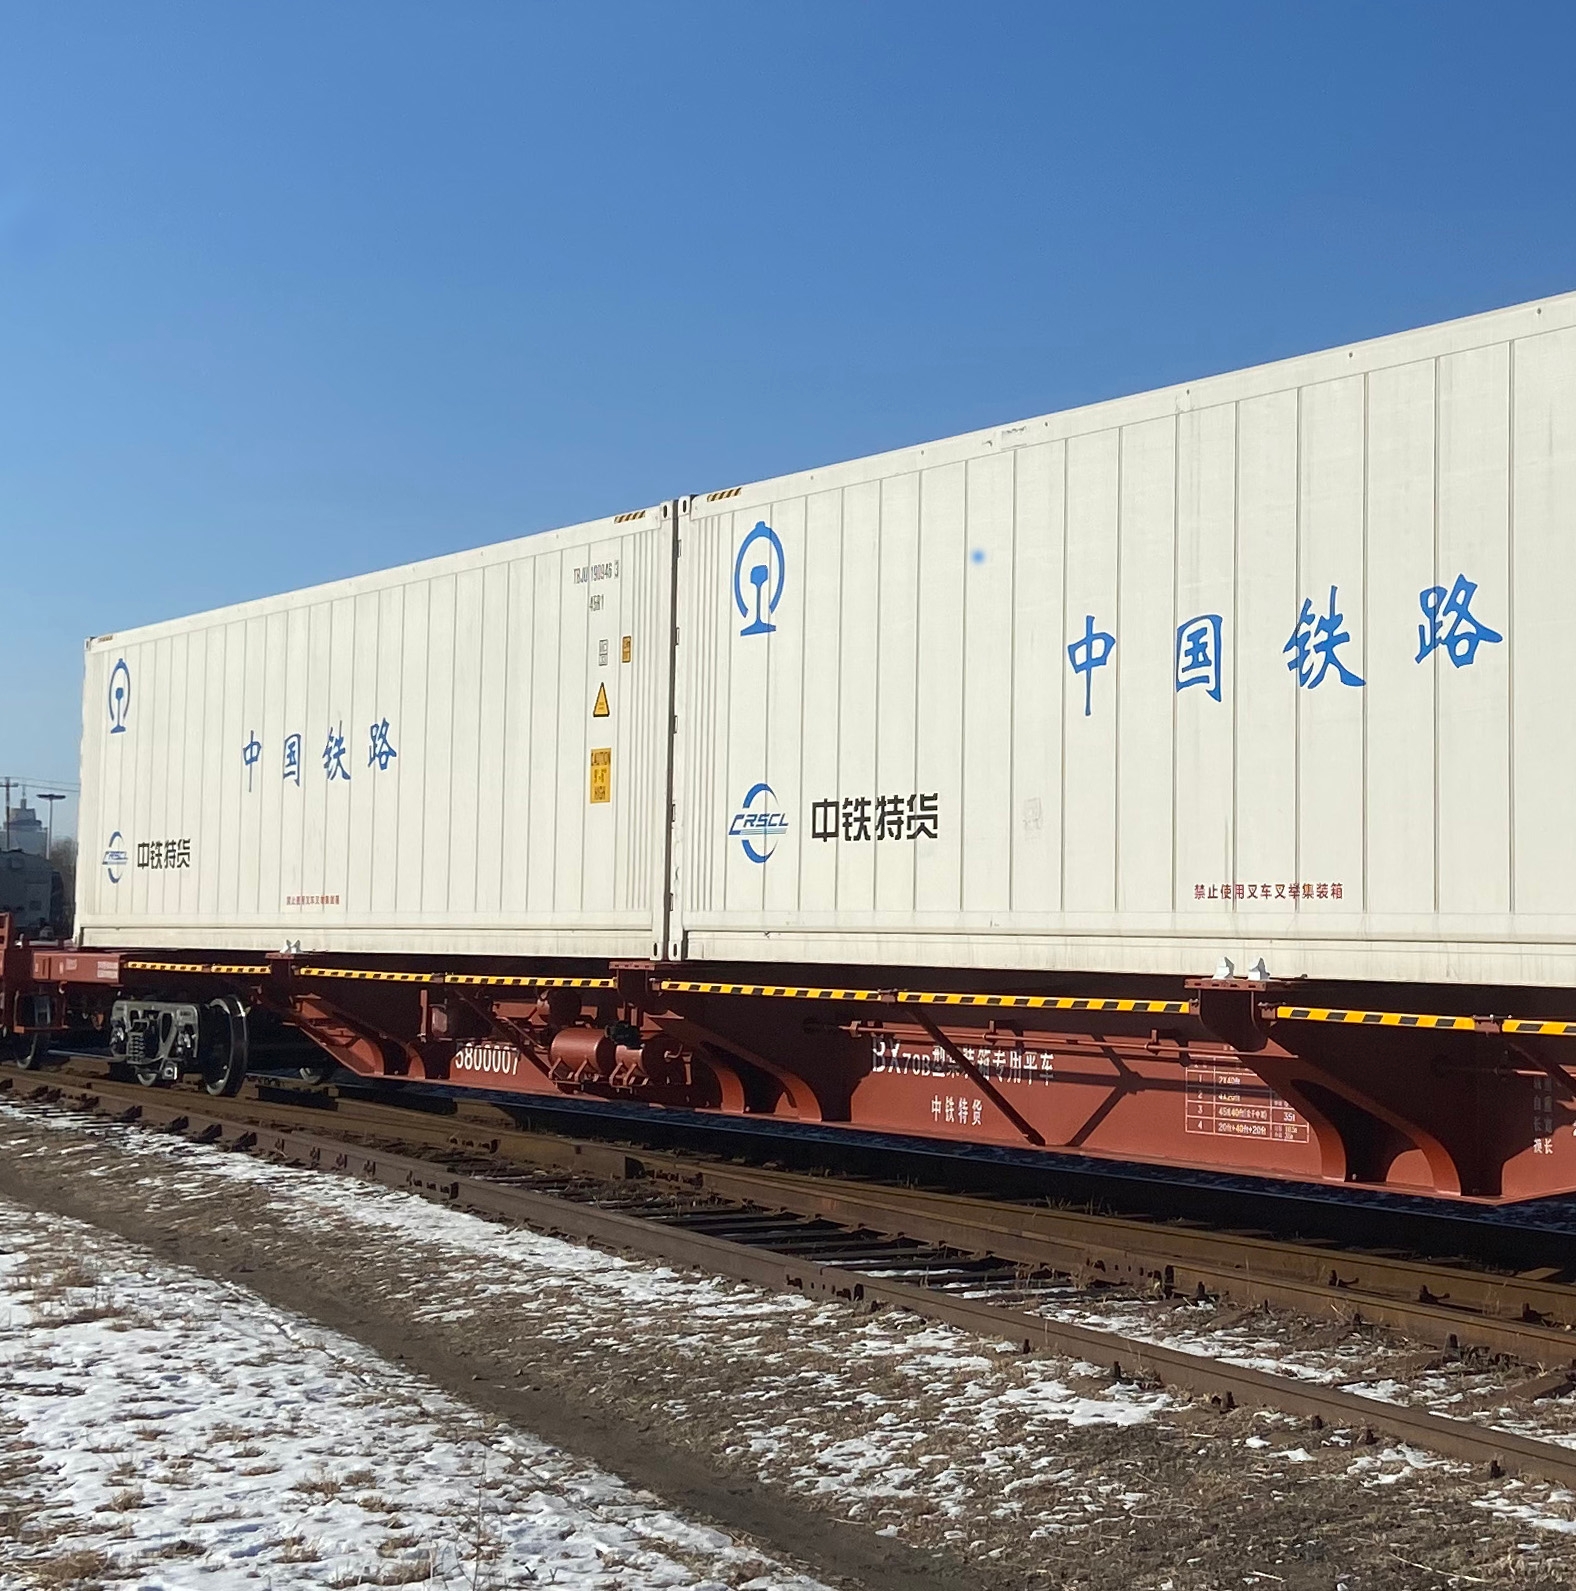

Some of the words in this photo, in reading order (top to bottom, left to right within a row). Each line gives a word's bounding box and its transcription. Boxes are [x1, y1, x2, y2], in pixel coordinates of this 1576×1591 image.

[1067, 573, 1503, 716] 中国铁路
[243, 717, 397, 793] 中国铁路
[728, 812, 789, 836] CRSCL
[811, 792, 939, 843] 中铁特货
[136, 838, 191, 870] 中铁特货
[1194, 882, 1344, 900] 禁止使用叉车叉举集装箱
[456, 1042, 520, 1076] 5800007
[931, 1094, 983, 1126] 中铁特货
